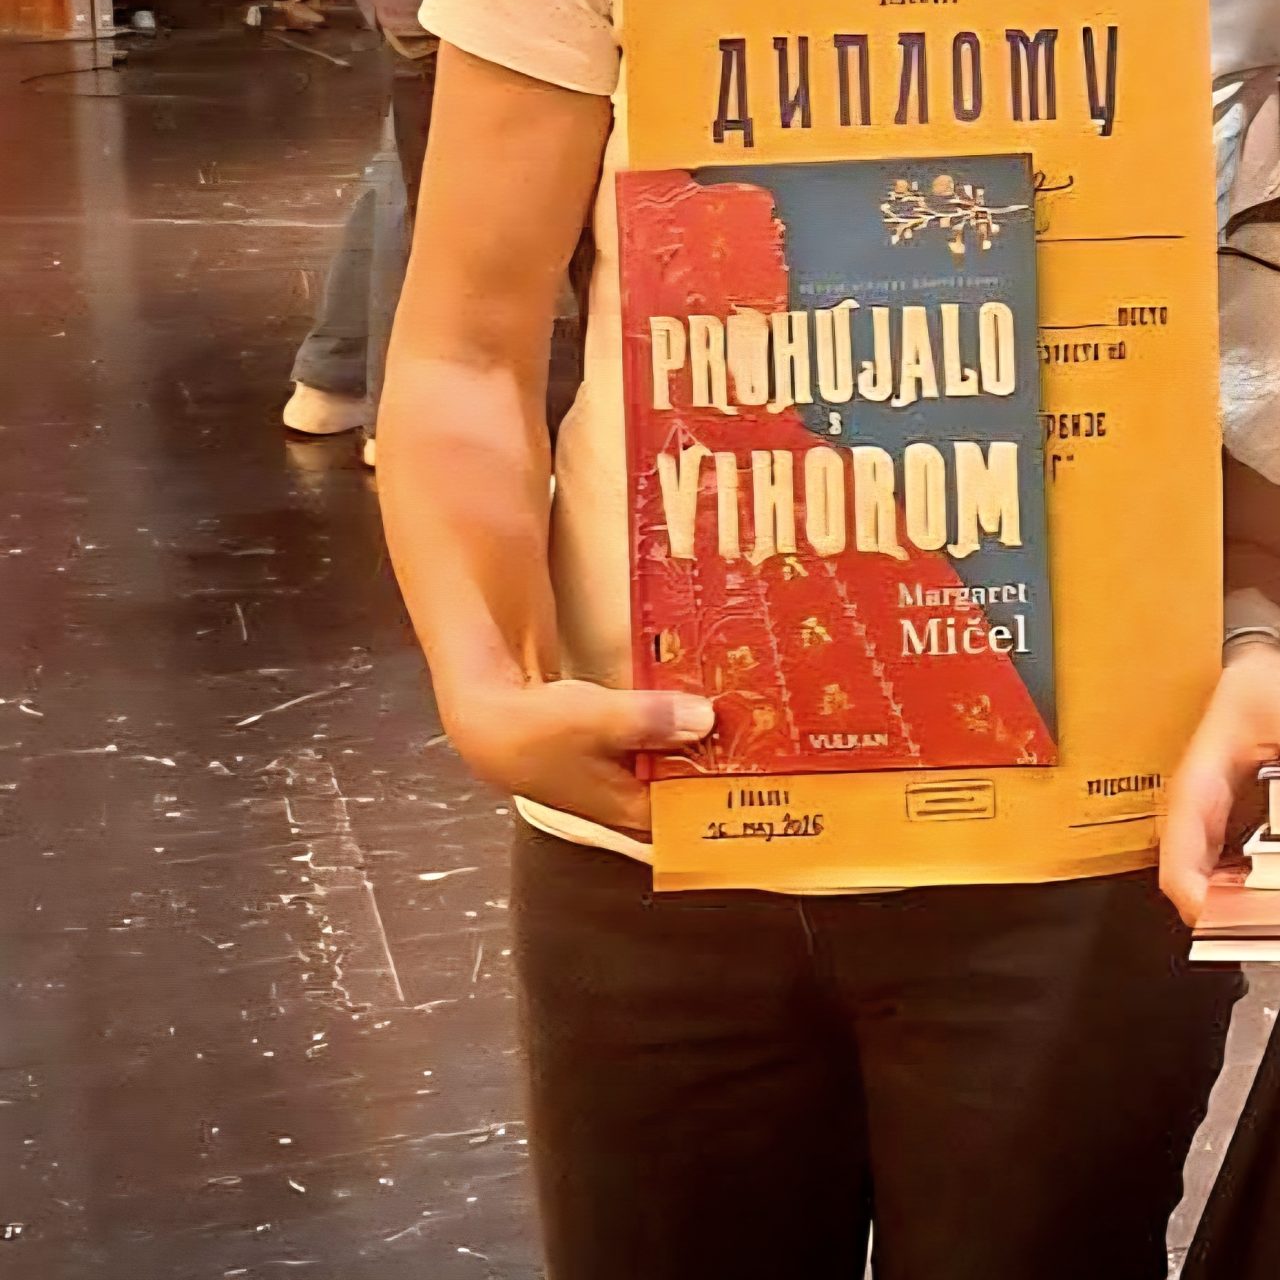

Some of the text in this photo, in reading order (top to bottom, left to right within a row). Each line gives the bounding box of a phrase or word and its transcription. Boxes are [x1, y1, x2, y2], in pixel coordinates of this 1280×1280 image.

[712, 25, 1119, 148] ДИПЛОМУ
[649, 299, 1016, 416] PROHUJALO
[656, 441, 1023, 566] VIHOROM
[898, 582, 1031, 611] Margaret
[900, 614, 1032, 656] Mičel
